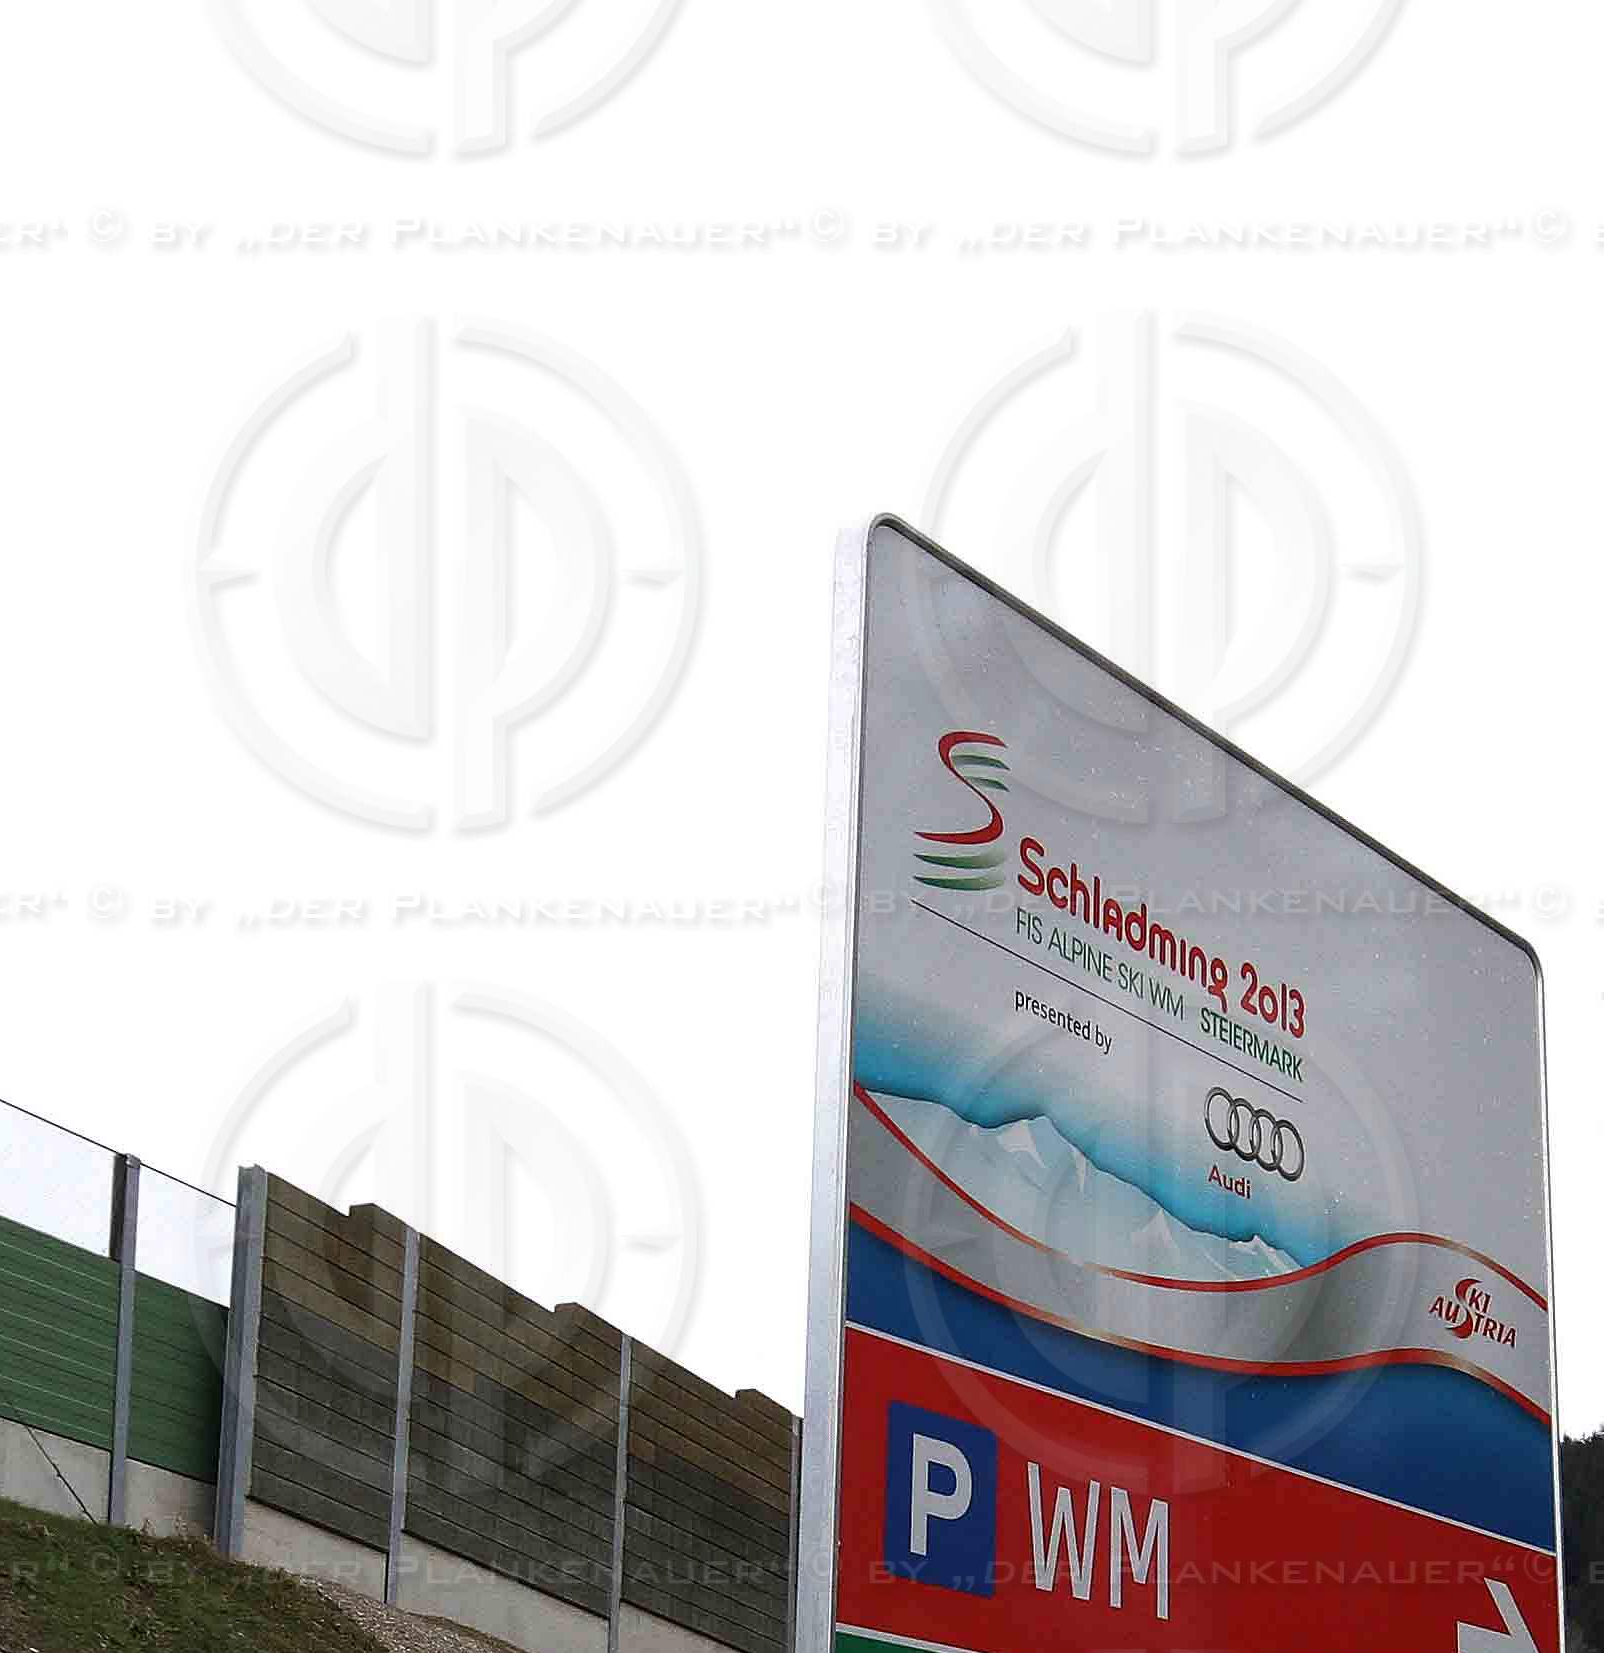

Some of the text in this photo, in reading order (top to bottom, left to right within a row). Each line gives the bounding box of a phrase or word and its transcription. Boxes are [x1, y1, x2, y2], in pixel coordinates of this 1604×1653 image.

[1013, 988, 1113, 1055] presented by
[1015, 906, 1303, 1082] FIS ALPINE SKI WM STEIERMARK
[1017, 835, 1306, 1039] Schladming 2013
[1207, 1163, 1253, 1200] Audi
[908, 1433, 1171, 1620] P WM
